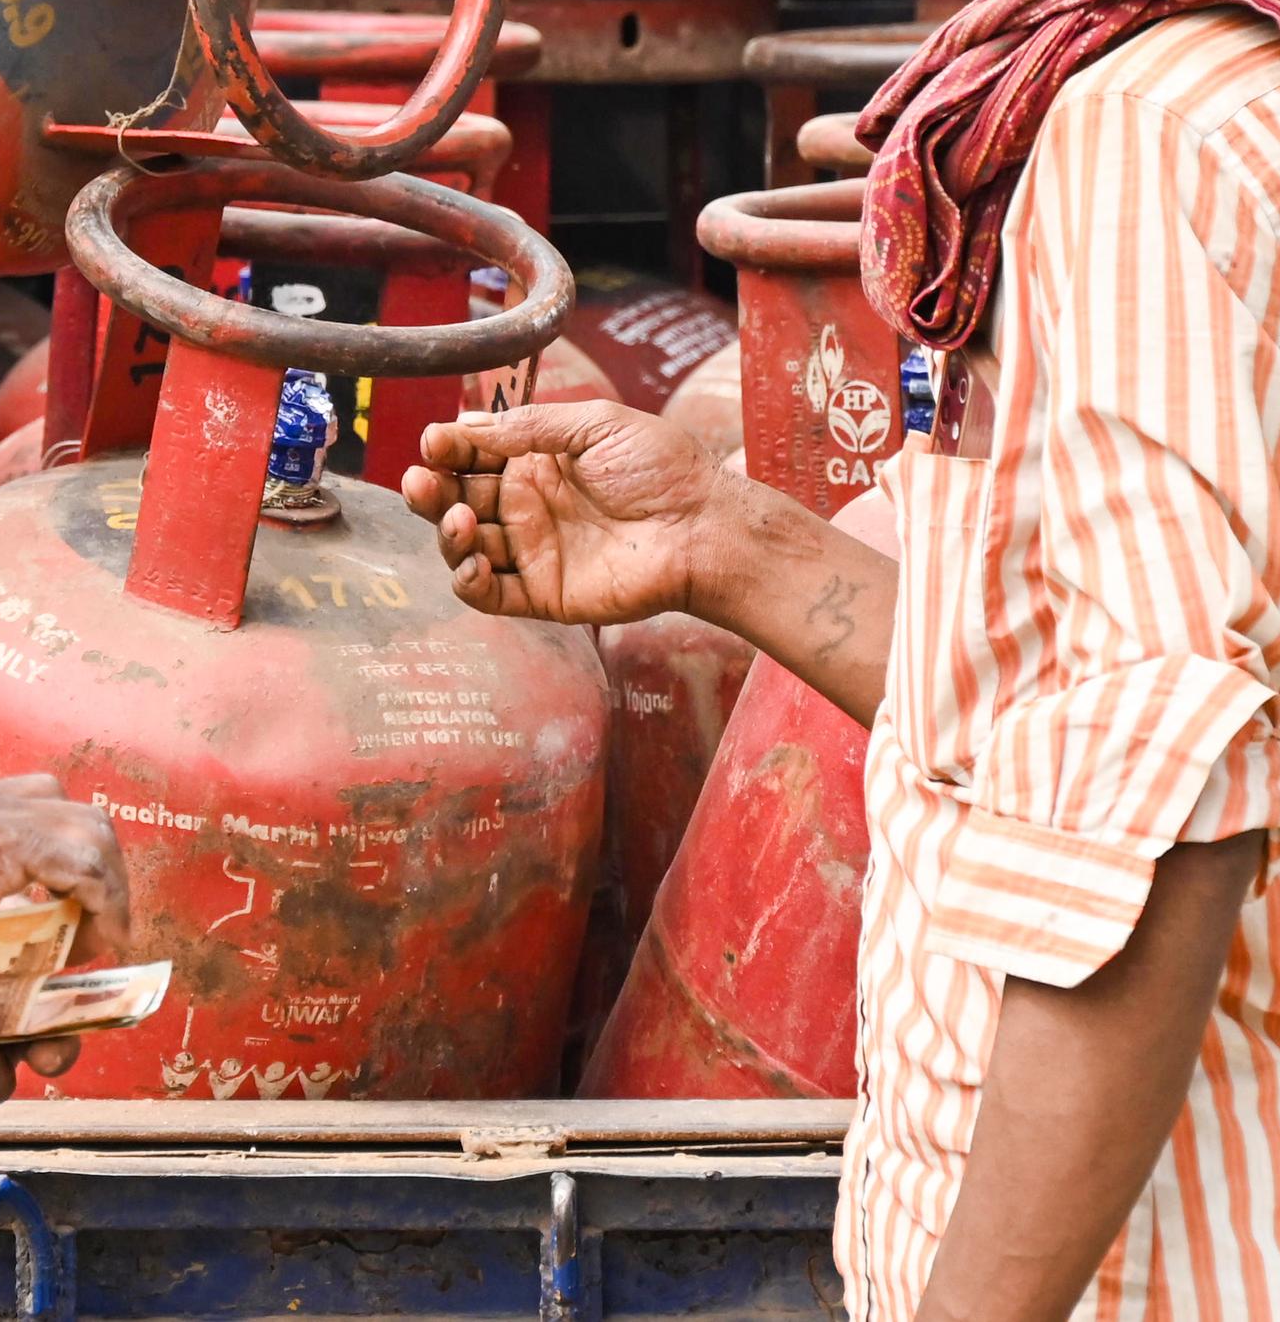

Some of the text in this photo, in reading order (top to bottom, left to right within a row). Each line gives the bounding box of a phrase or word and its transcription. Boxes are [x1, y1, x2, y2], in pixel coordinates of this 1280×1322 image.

[842, 388, 878, 411] HP
[278, 573, 413, 611] 17.0
[376, 691, 492, 706] SWITCH OFF
[382, 711, 499, 727] REGULATOR
[356, 731, 419, 750] WHEN
[422, 730, 462, 747] NOT
[468, 731, 487, 747] IN
[221, 813, 320, 847] Mantri
